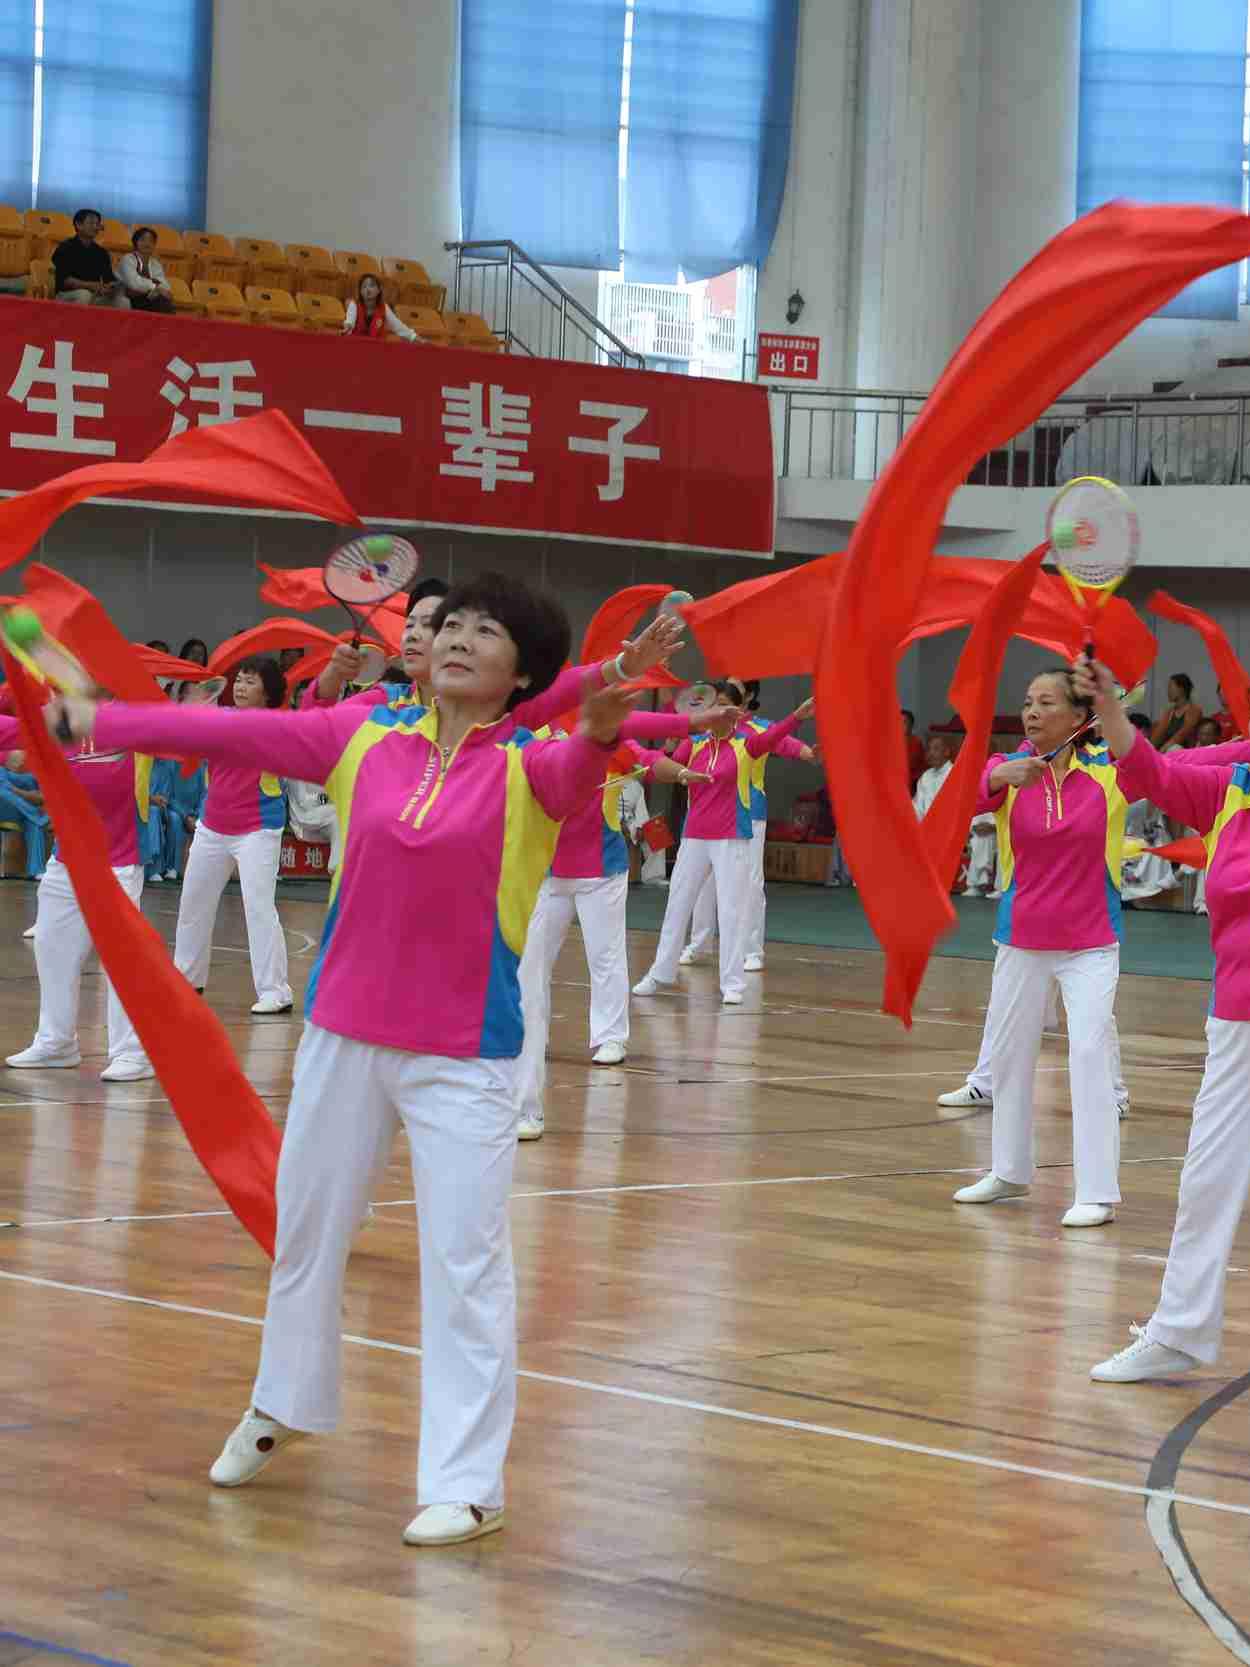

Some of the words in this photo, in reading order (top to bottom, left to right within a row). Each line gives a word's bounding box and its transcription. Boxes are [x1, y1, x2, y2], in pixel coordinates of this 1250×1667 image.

[769, 351, 808, 373] 出口
[7, 340, 661, 501] 生活一辈子
